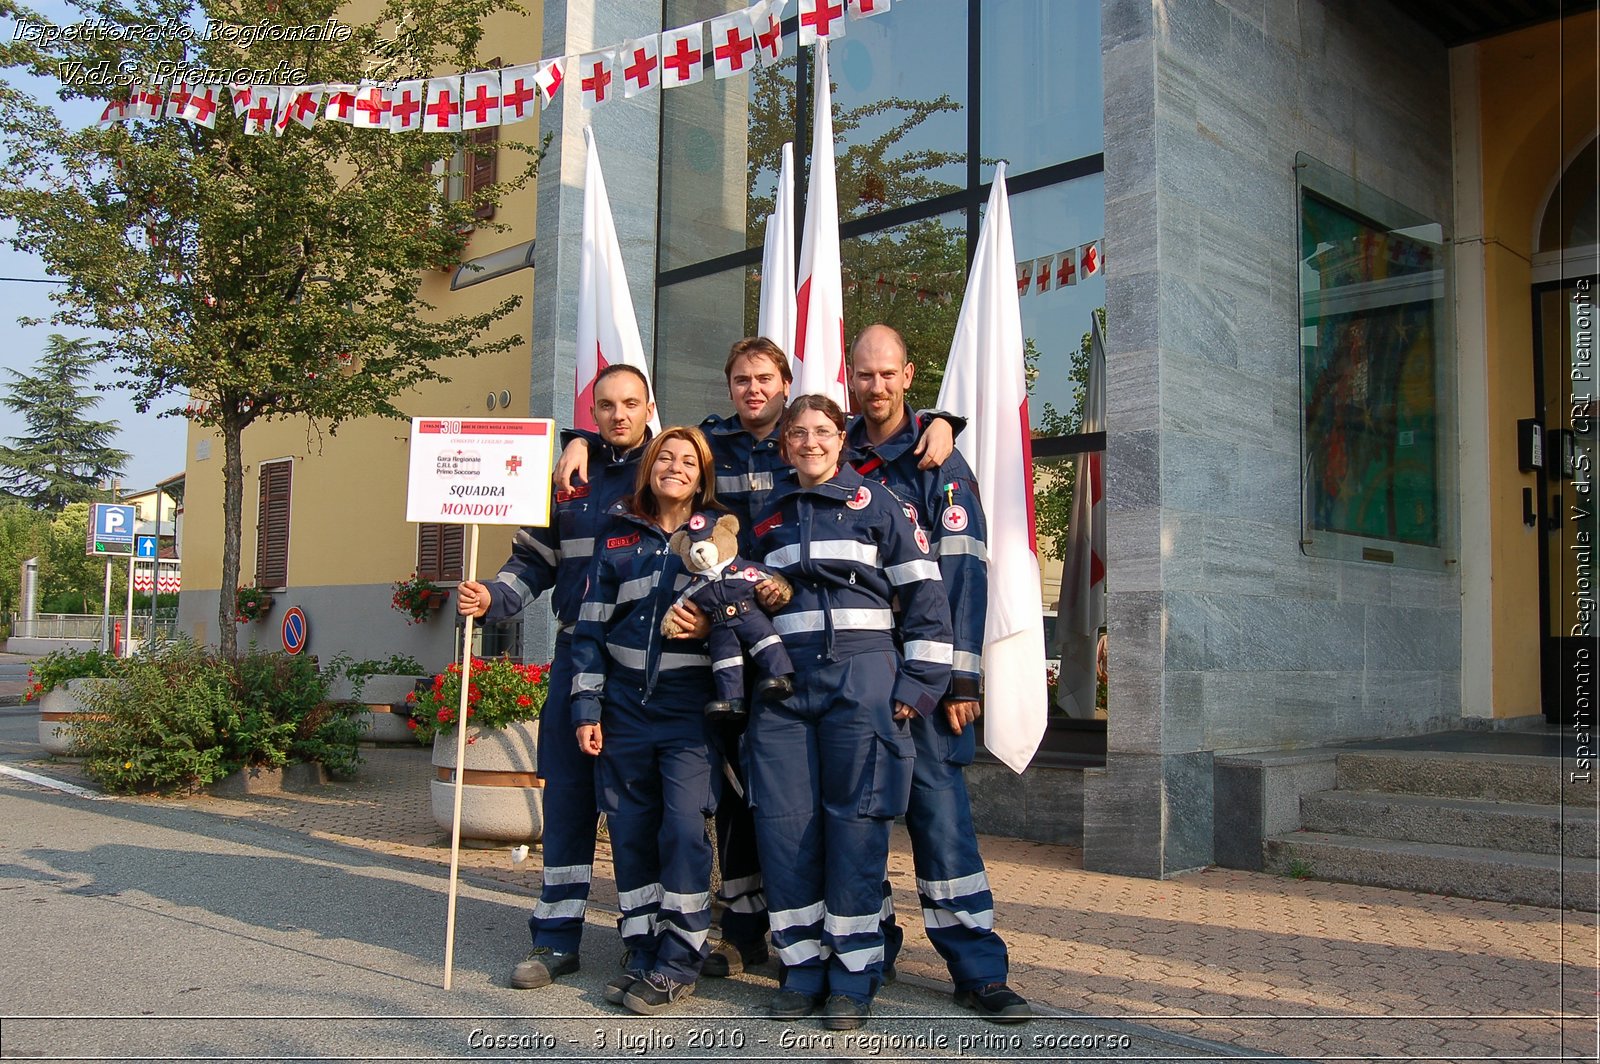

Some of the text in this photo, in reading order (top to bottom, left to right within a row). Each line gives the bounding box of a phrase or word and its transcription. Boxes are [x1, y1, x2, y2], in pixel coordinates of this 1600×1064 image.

[449, 485, 505, 497] SQUADRA
[440, 503, 513, 517] MONDOVI'
[105, 512, 124, 533] P
